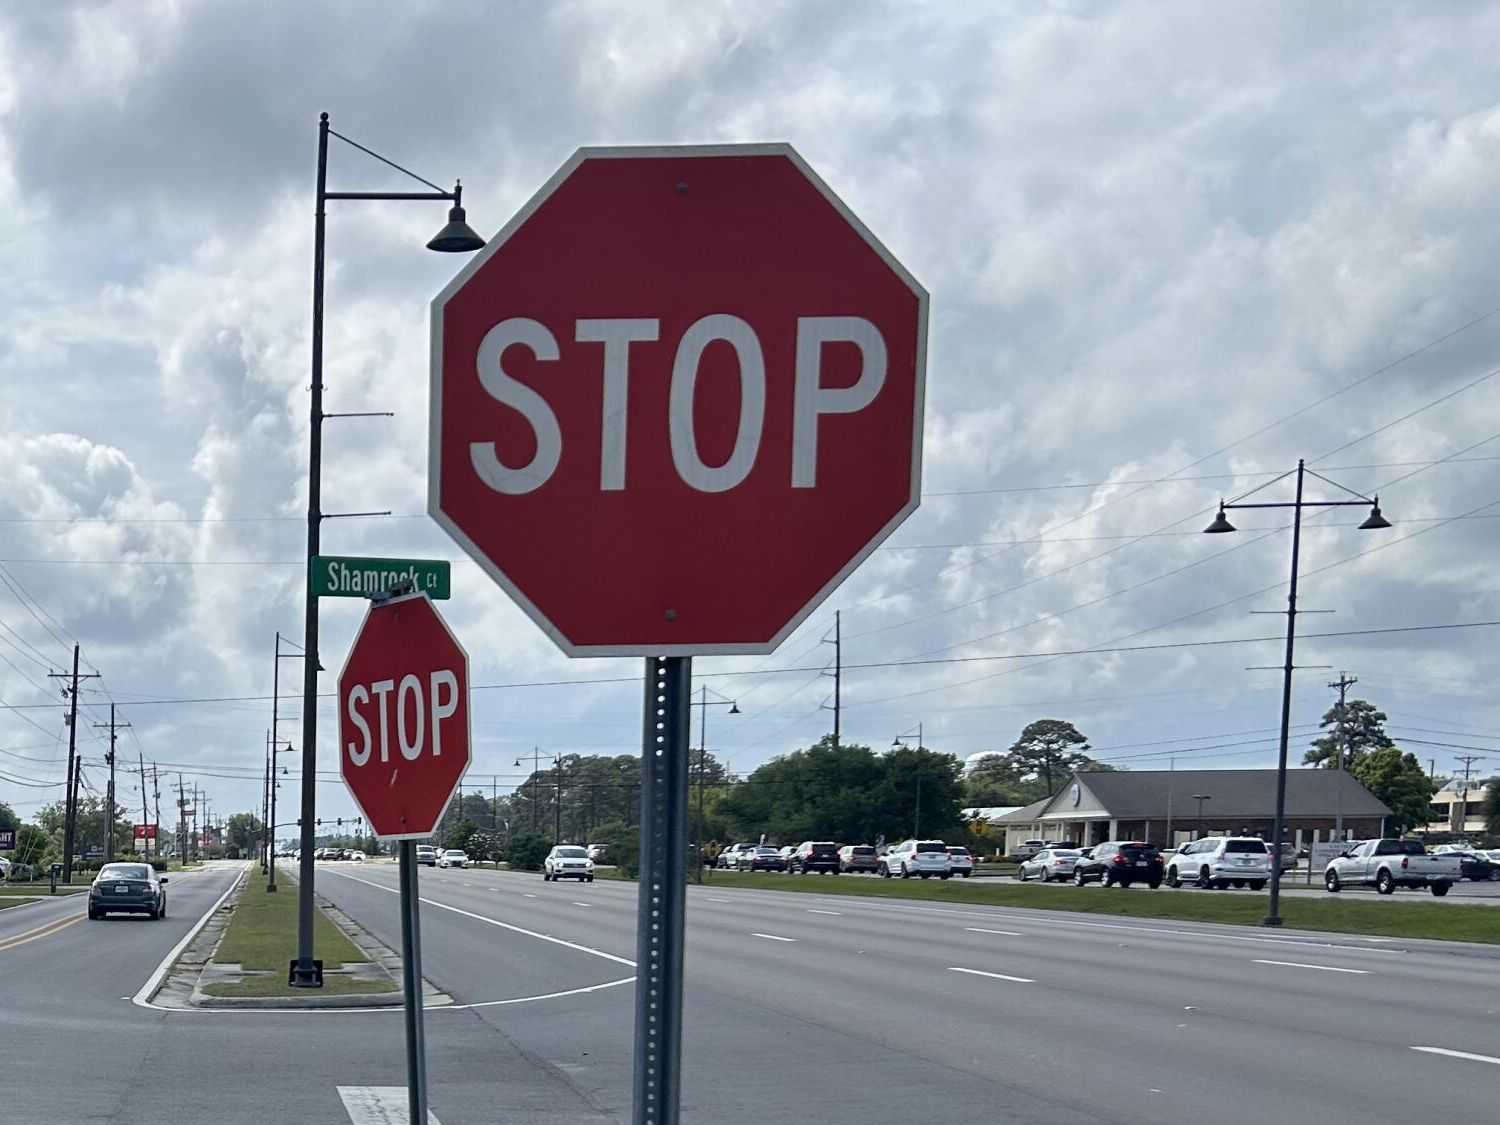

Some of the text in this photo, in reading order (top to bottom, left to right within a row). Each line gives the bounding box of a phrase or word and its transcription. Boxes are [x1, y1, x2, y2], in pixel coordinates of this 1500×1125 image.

[468, 313, 888, 496] STOP
[426, 572, 437, 588] Ct
[347, 669, 459, 767] STOP
